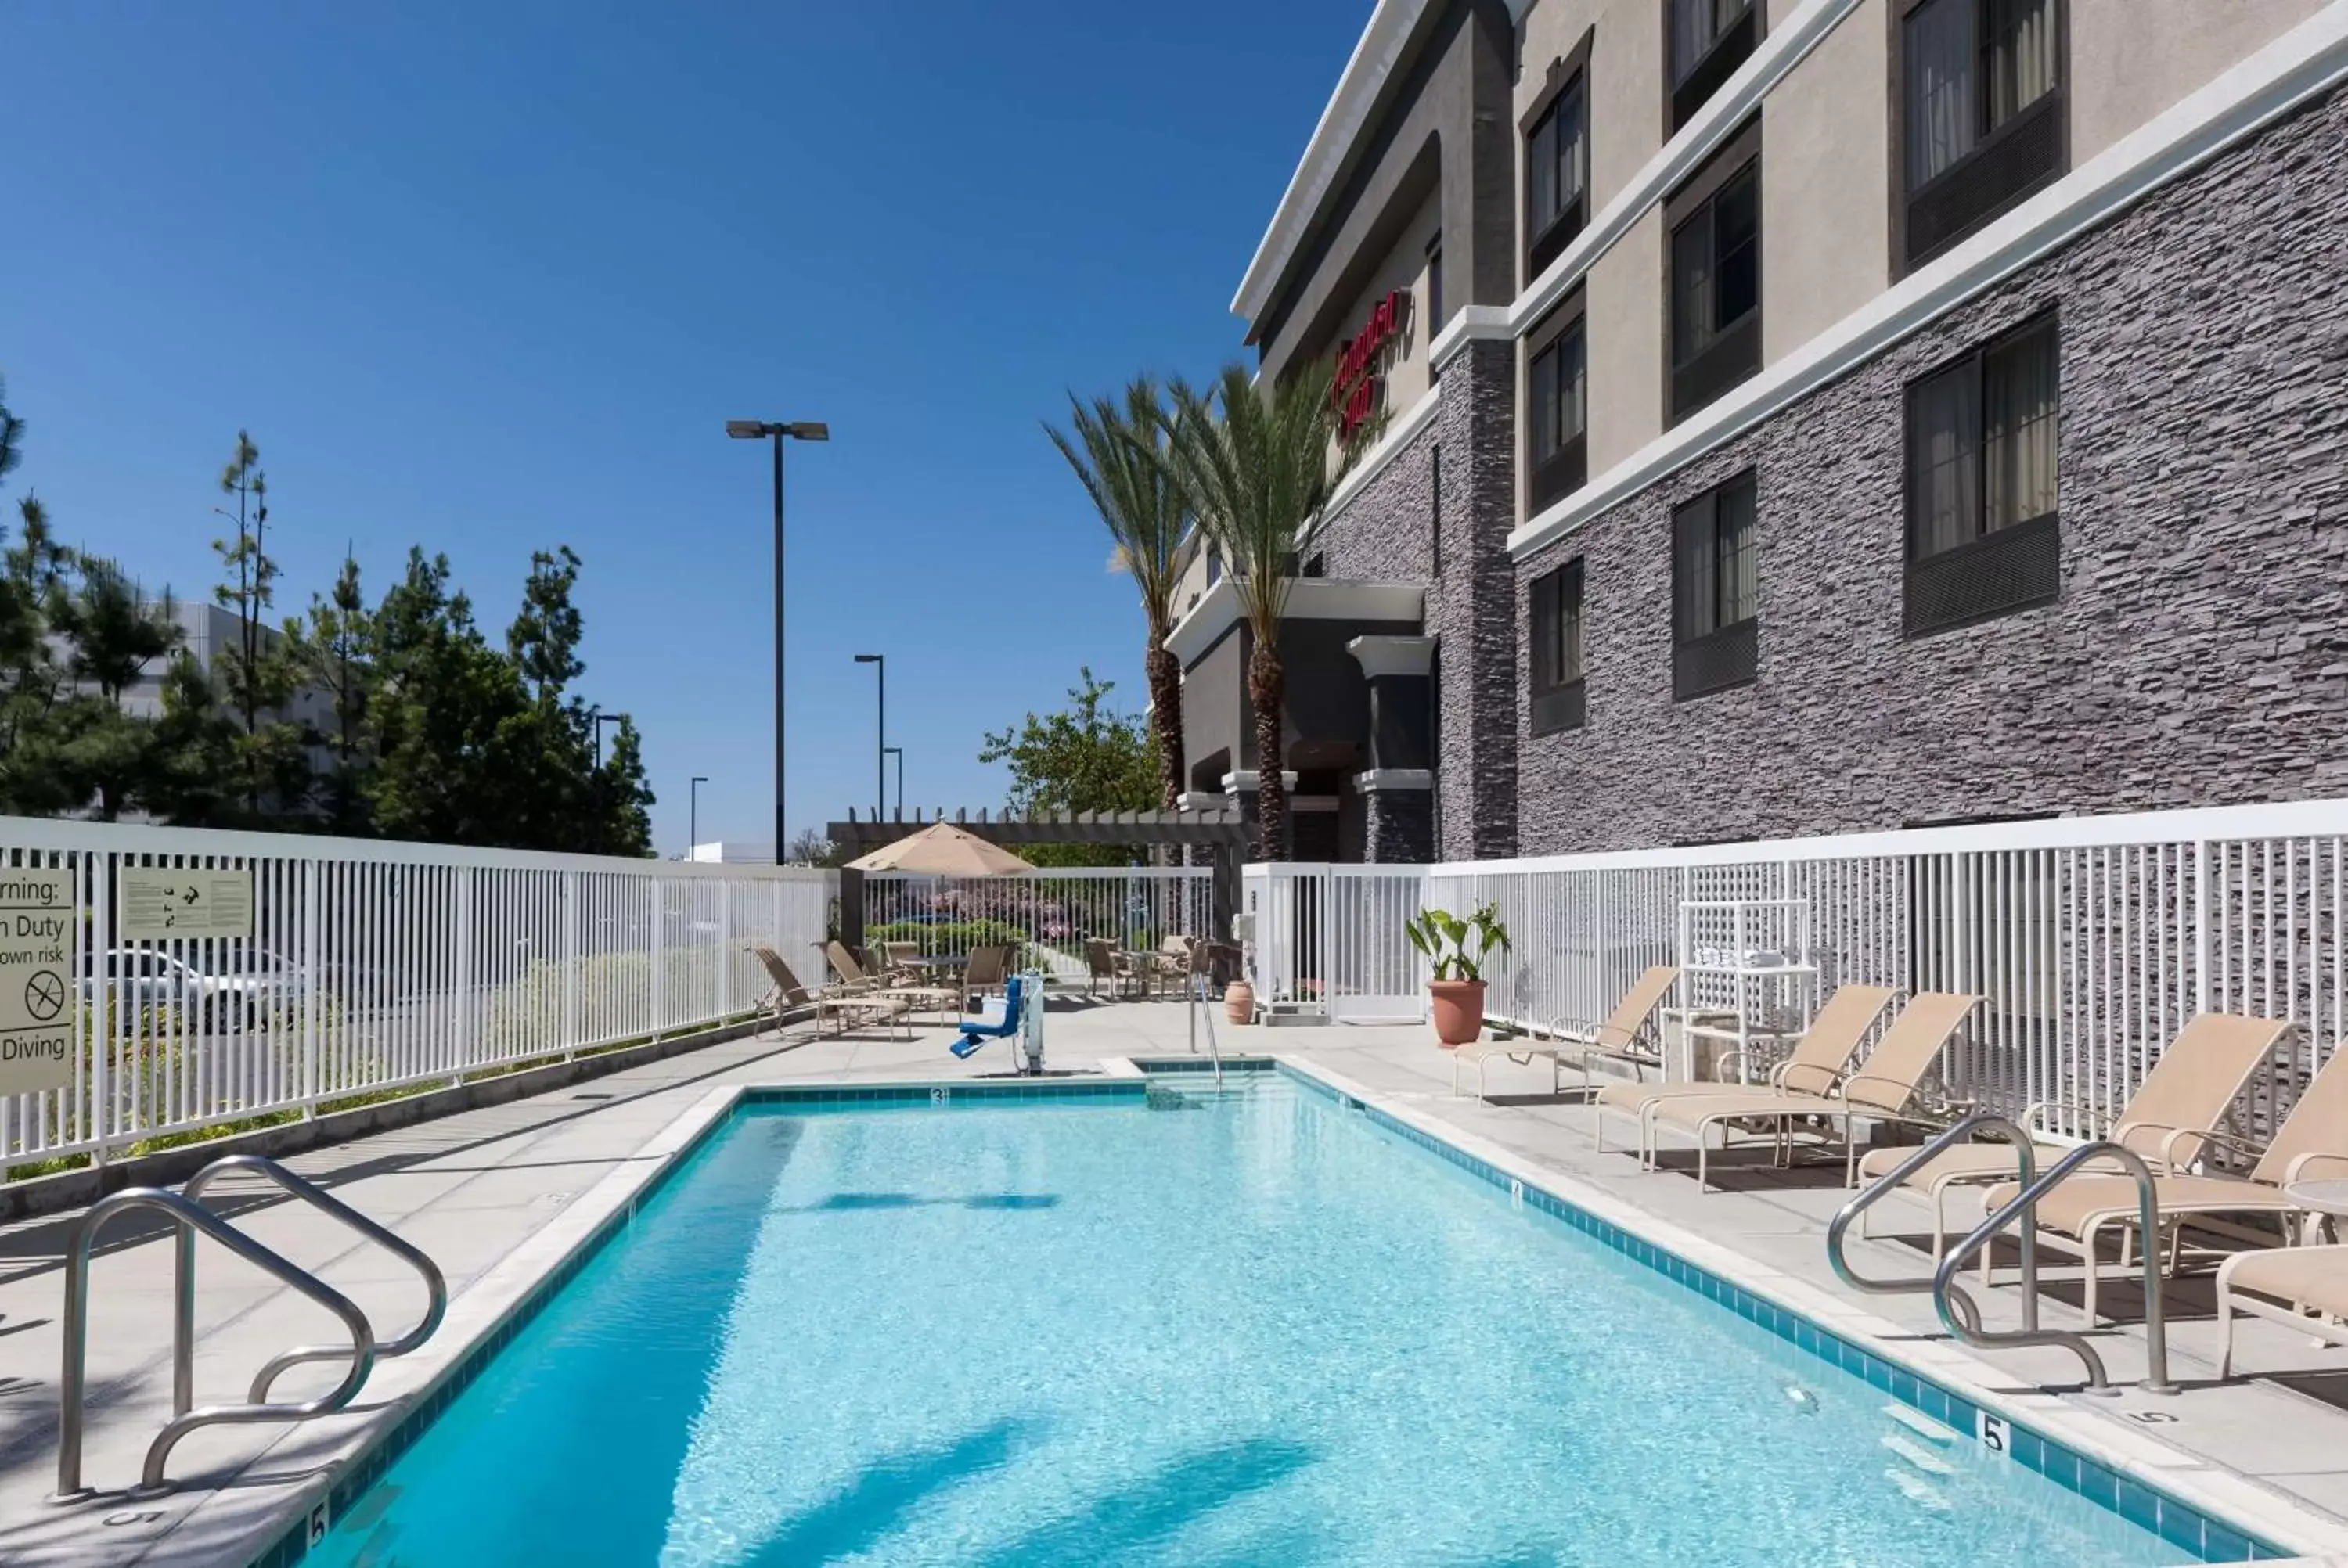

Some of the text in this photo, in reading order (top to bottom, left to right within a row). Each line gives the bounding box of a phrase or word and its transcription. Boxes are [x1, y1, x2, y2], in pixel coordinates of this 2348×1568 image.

[17, 915, 64, 943] Duty
[0, 945, 63, 964] own risk
[3, 1034, 65, 1061] Diving
[2128, 1412, 2180, 1423] 5
[1984, 1415, 2003, 1451] 5
[101, 1510, 167, 1526] 5
[312, 1502, 325, 1549] 5
